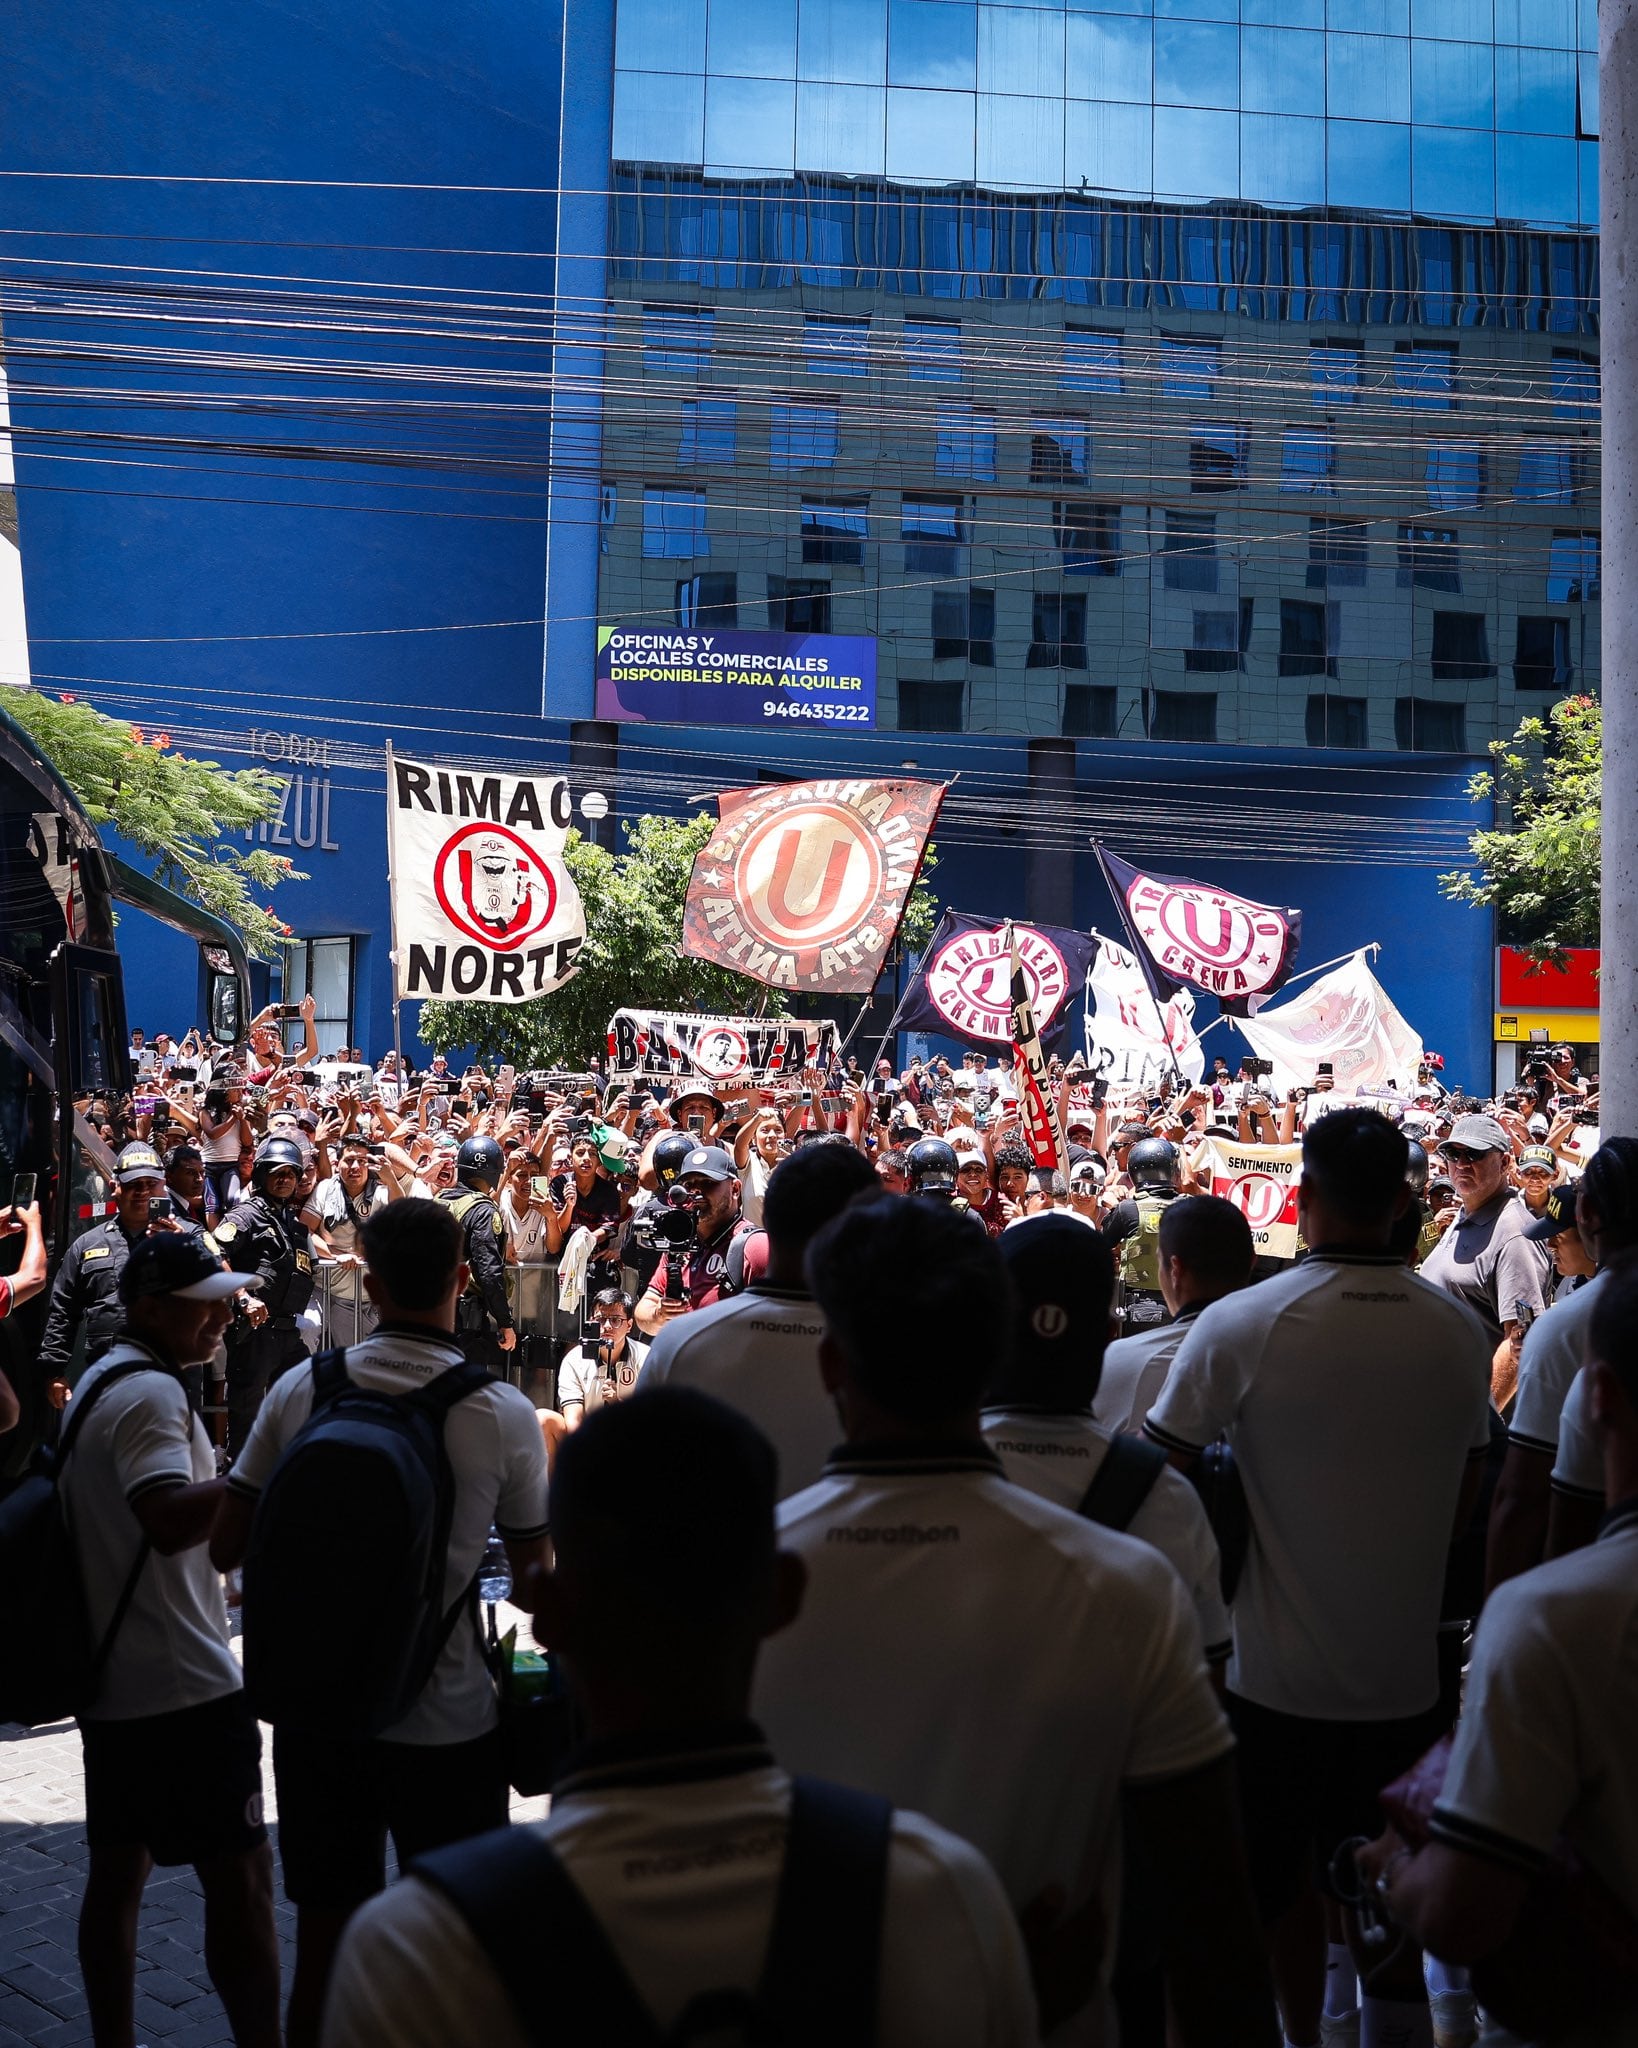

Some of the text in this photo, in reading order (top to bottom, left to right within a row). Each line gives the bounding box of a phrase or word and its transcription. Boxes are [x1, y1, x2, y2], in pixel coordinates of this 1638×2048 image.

[610, 634, 714, 651] OFICINAS Y
[610, 650, 829, 672] LOCALES COMERCIALES
[611, 667, 862, 690] DISPONIBLES PARA ALQUILER
[763, 701, 870, 721] 946435222
[407, 936, 583, 997] NORTE
[1162, 945, 1248, 991] CREMA
[1522, 1147, 1554, 1163] POLICIA
[1227, 1156, 1293, 1174] SENTIMIENTO
[1341, 1290, 1409, 1302] marathon
[363, 1355, 434, 1374] marathon
[995, 1440, 1090, 1458] marathon
[826, 1523, 961, 1544] marathon
